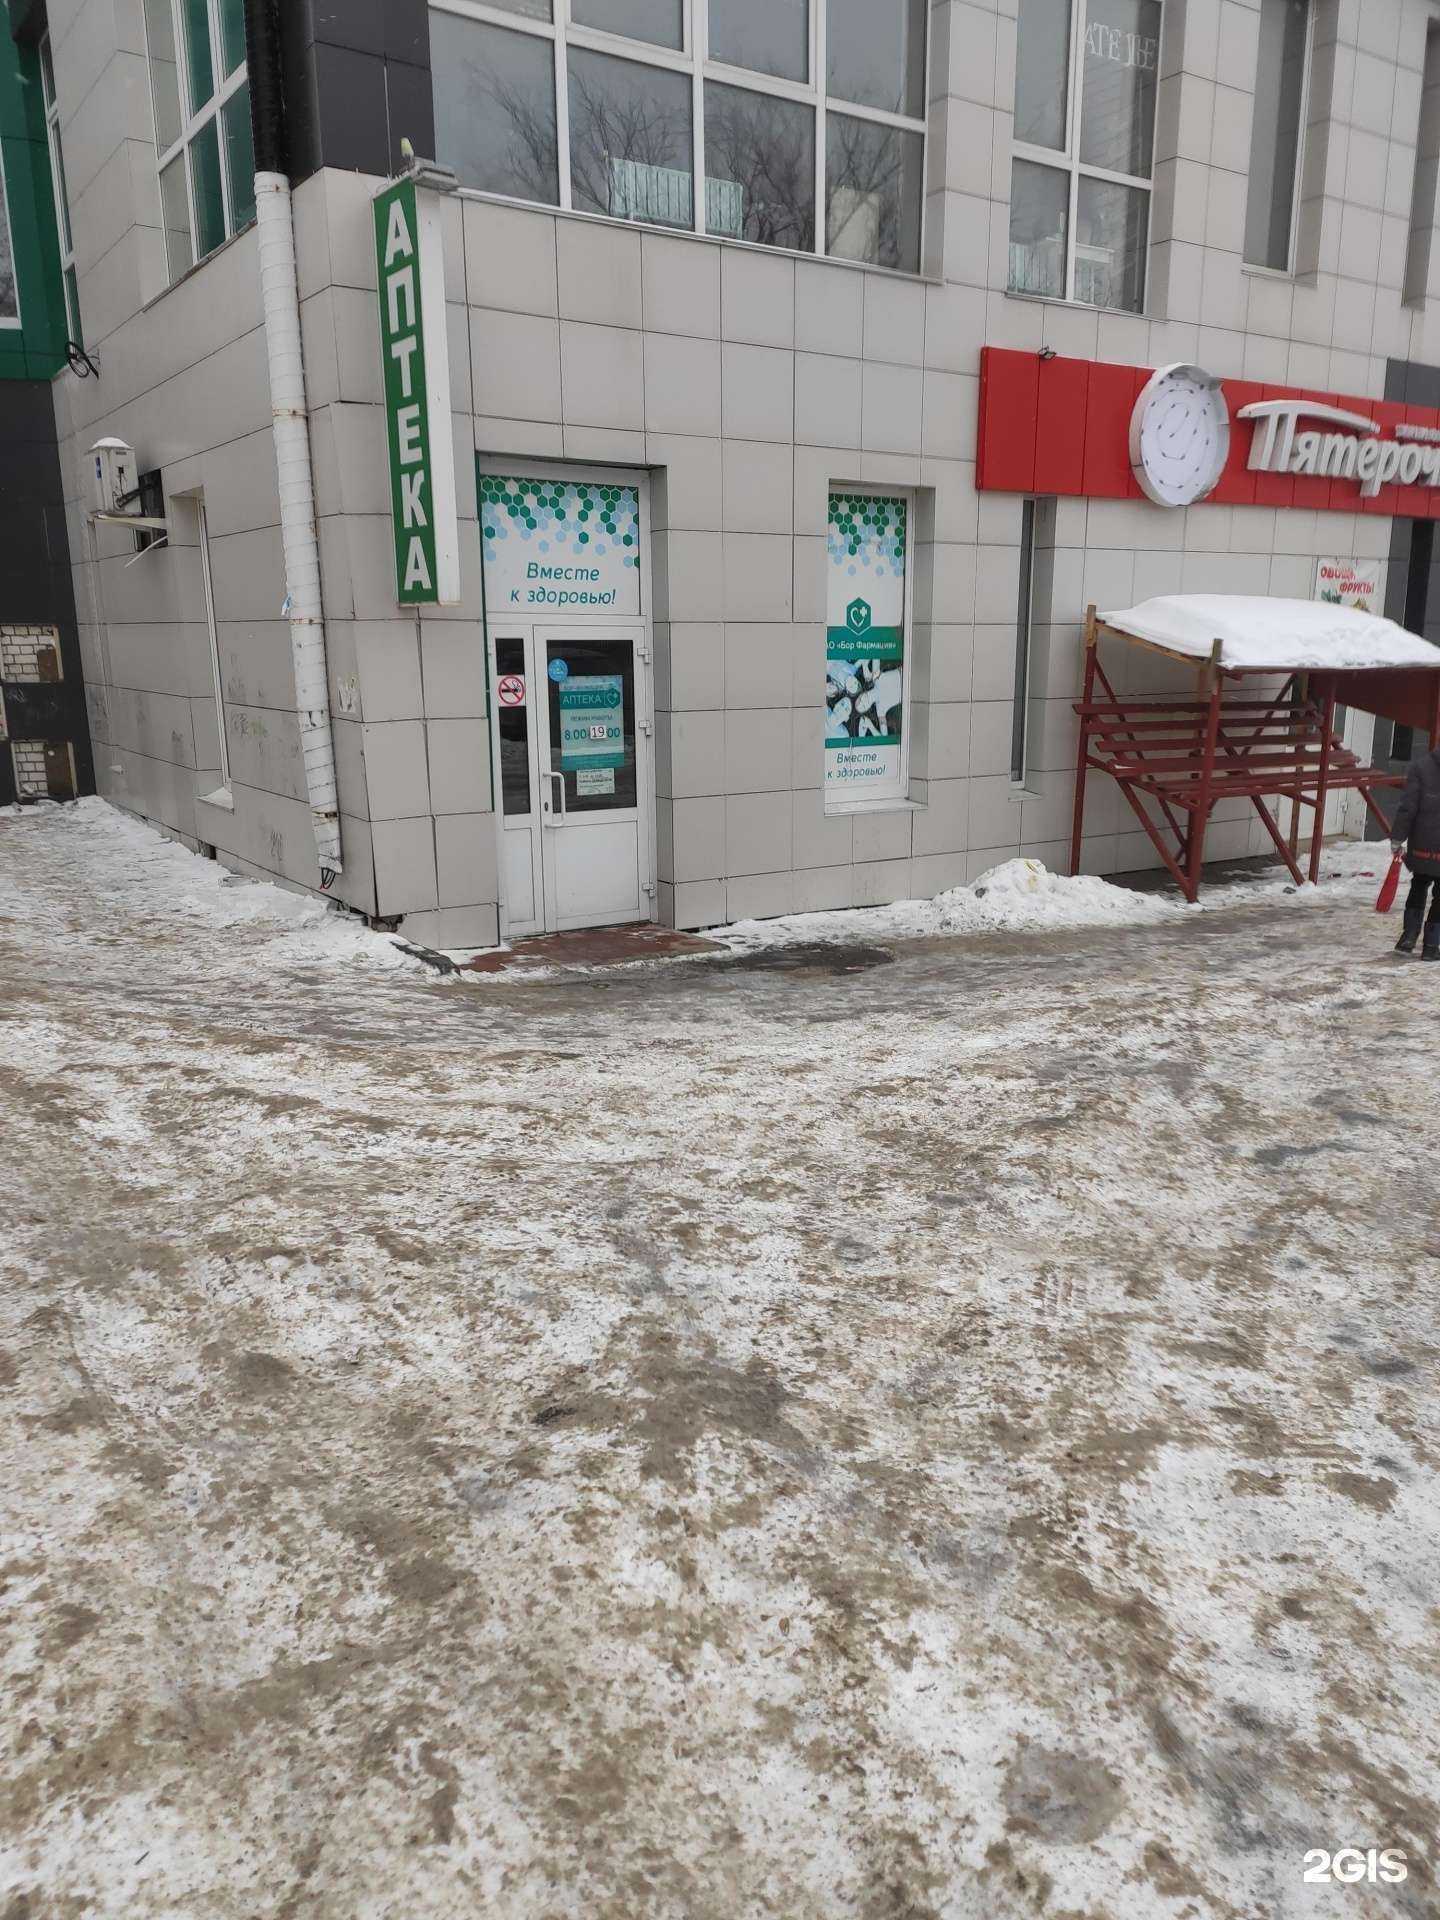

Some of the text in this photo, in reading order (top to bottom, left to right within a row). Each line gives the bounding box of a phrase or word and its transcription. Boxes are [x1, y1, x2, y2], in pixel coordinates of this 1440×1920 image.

[384, 198, 433, 591] АПТЕКА
[526, 561, 600, 581] Вместе
[510, 586, 616, 607] к здоровью!
[562, 694, 602, 705] АПТЕКА
[837, 752, 877, 764] Вместе
[827, 764, 886, 779] к здоровью!
